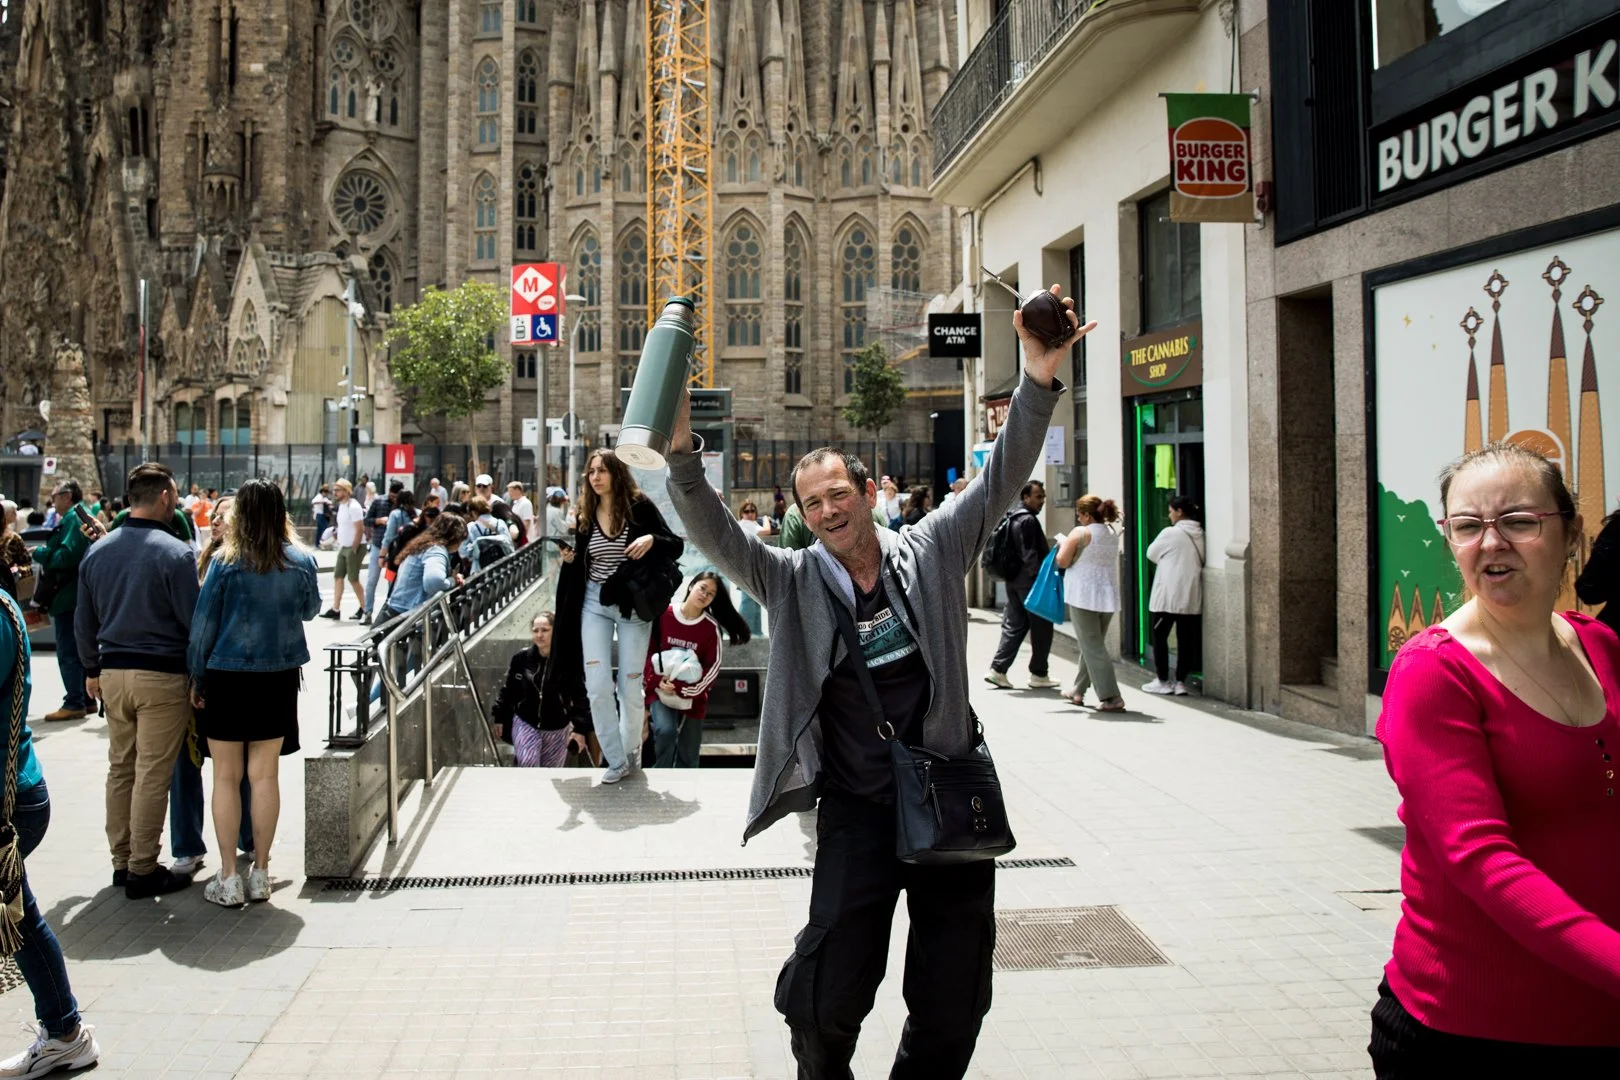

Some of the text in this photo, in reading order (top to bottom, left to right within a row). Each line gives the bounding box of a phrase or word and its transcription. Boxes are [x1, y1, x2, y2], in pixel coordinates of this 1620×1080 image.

[1378, 39, 1620, 193] BURGER K
[1176, 143, 1245, 159] BURGER
[1177, 159, 1246, 182] KING
[523, 277, 538, 293] M
[934, 326, 977, 336] CHANGE
[945, 336, 966, 344] ATM
[1130, 336, 1189, 366] THE CANNABIS
[1149, 363, 1167, 379] SHOP
